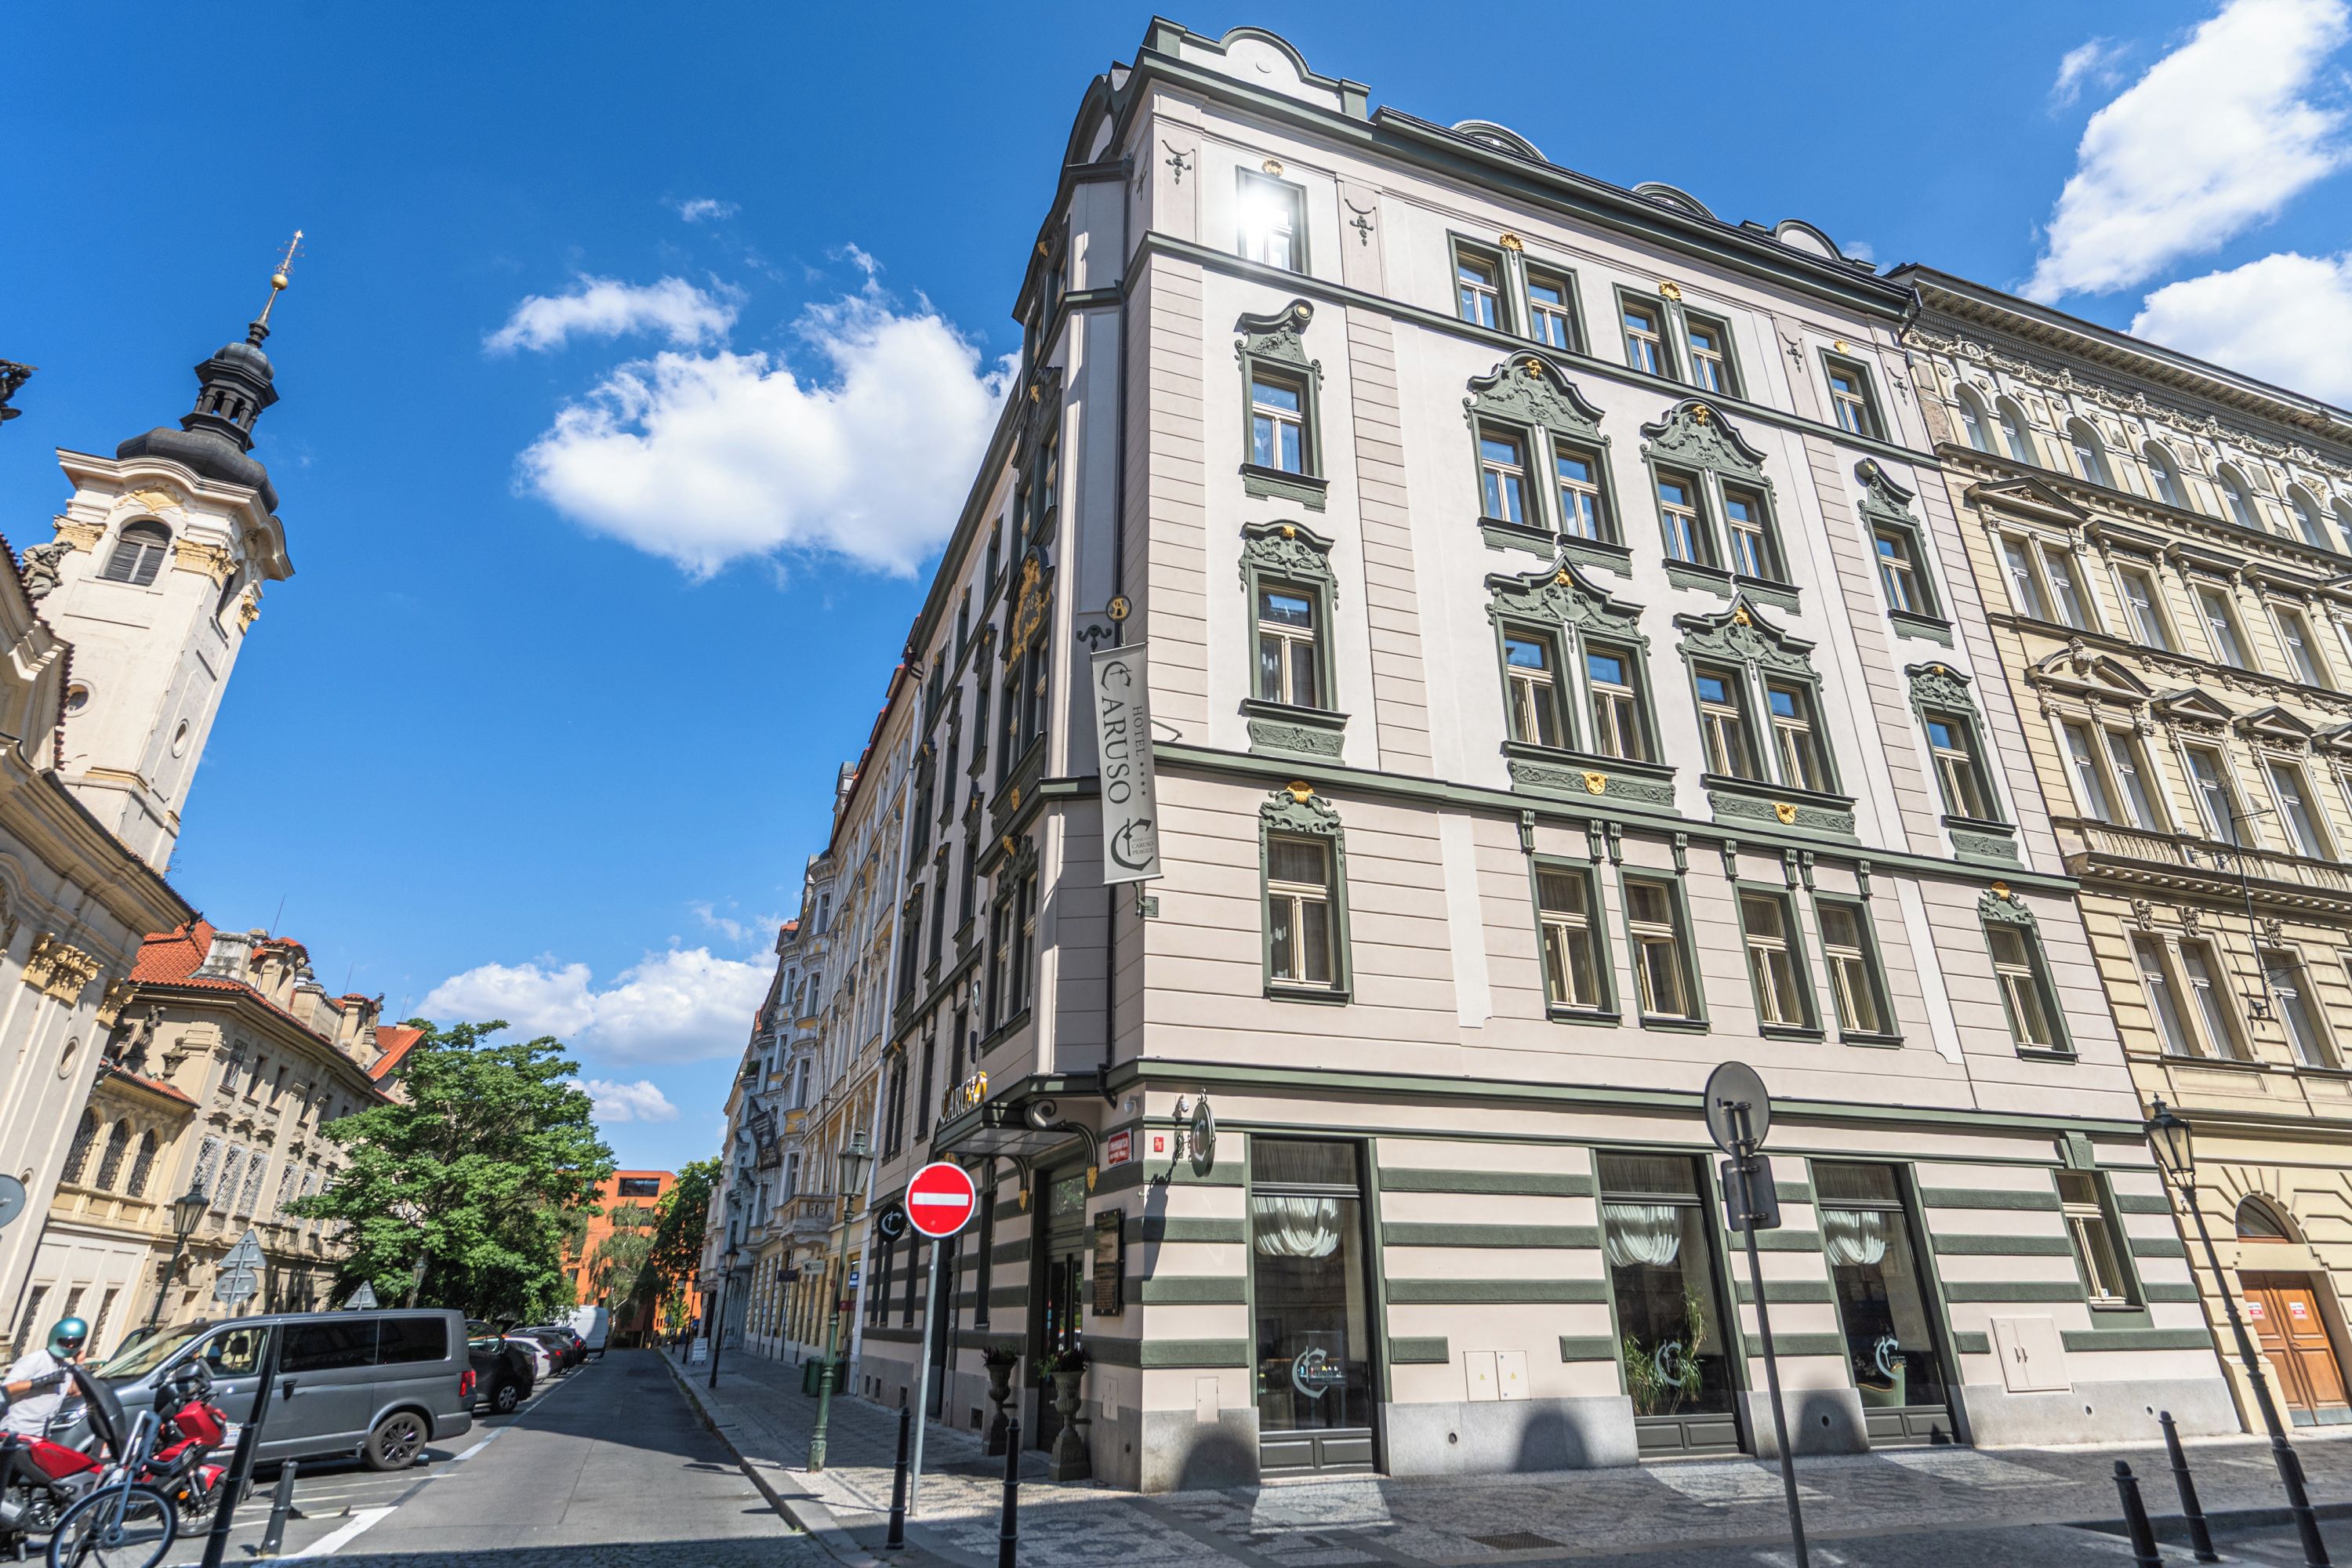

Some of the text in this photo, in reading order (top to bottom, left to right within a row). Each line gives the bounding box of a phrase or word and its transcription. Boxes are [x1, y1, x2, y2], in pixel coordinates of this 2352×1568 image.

[1101, 660, 1132, 804] CARUSO
[1133, 706, 1145, 757] HOTEL
[940, 1071, 988, 1124] CARUSO
